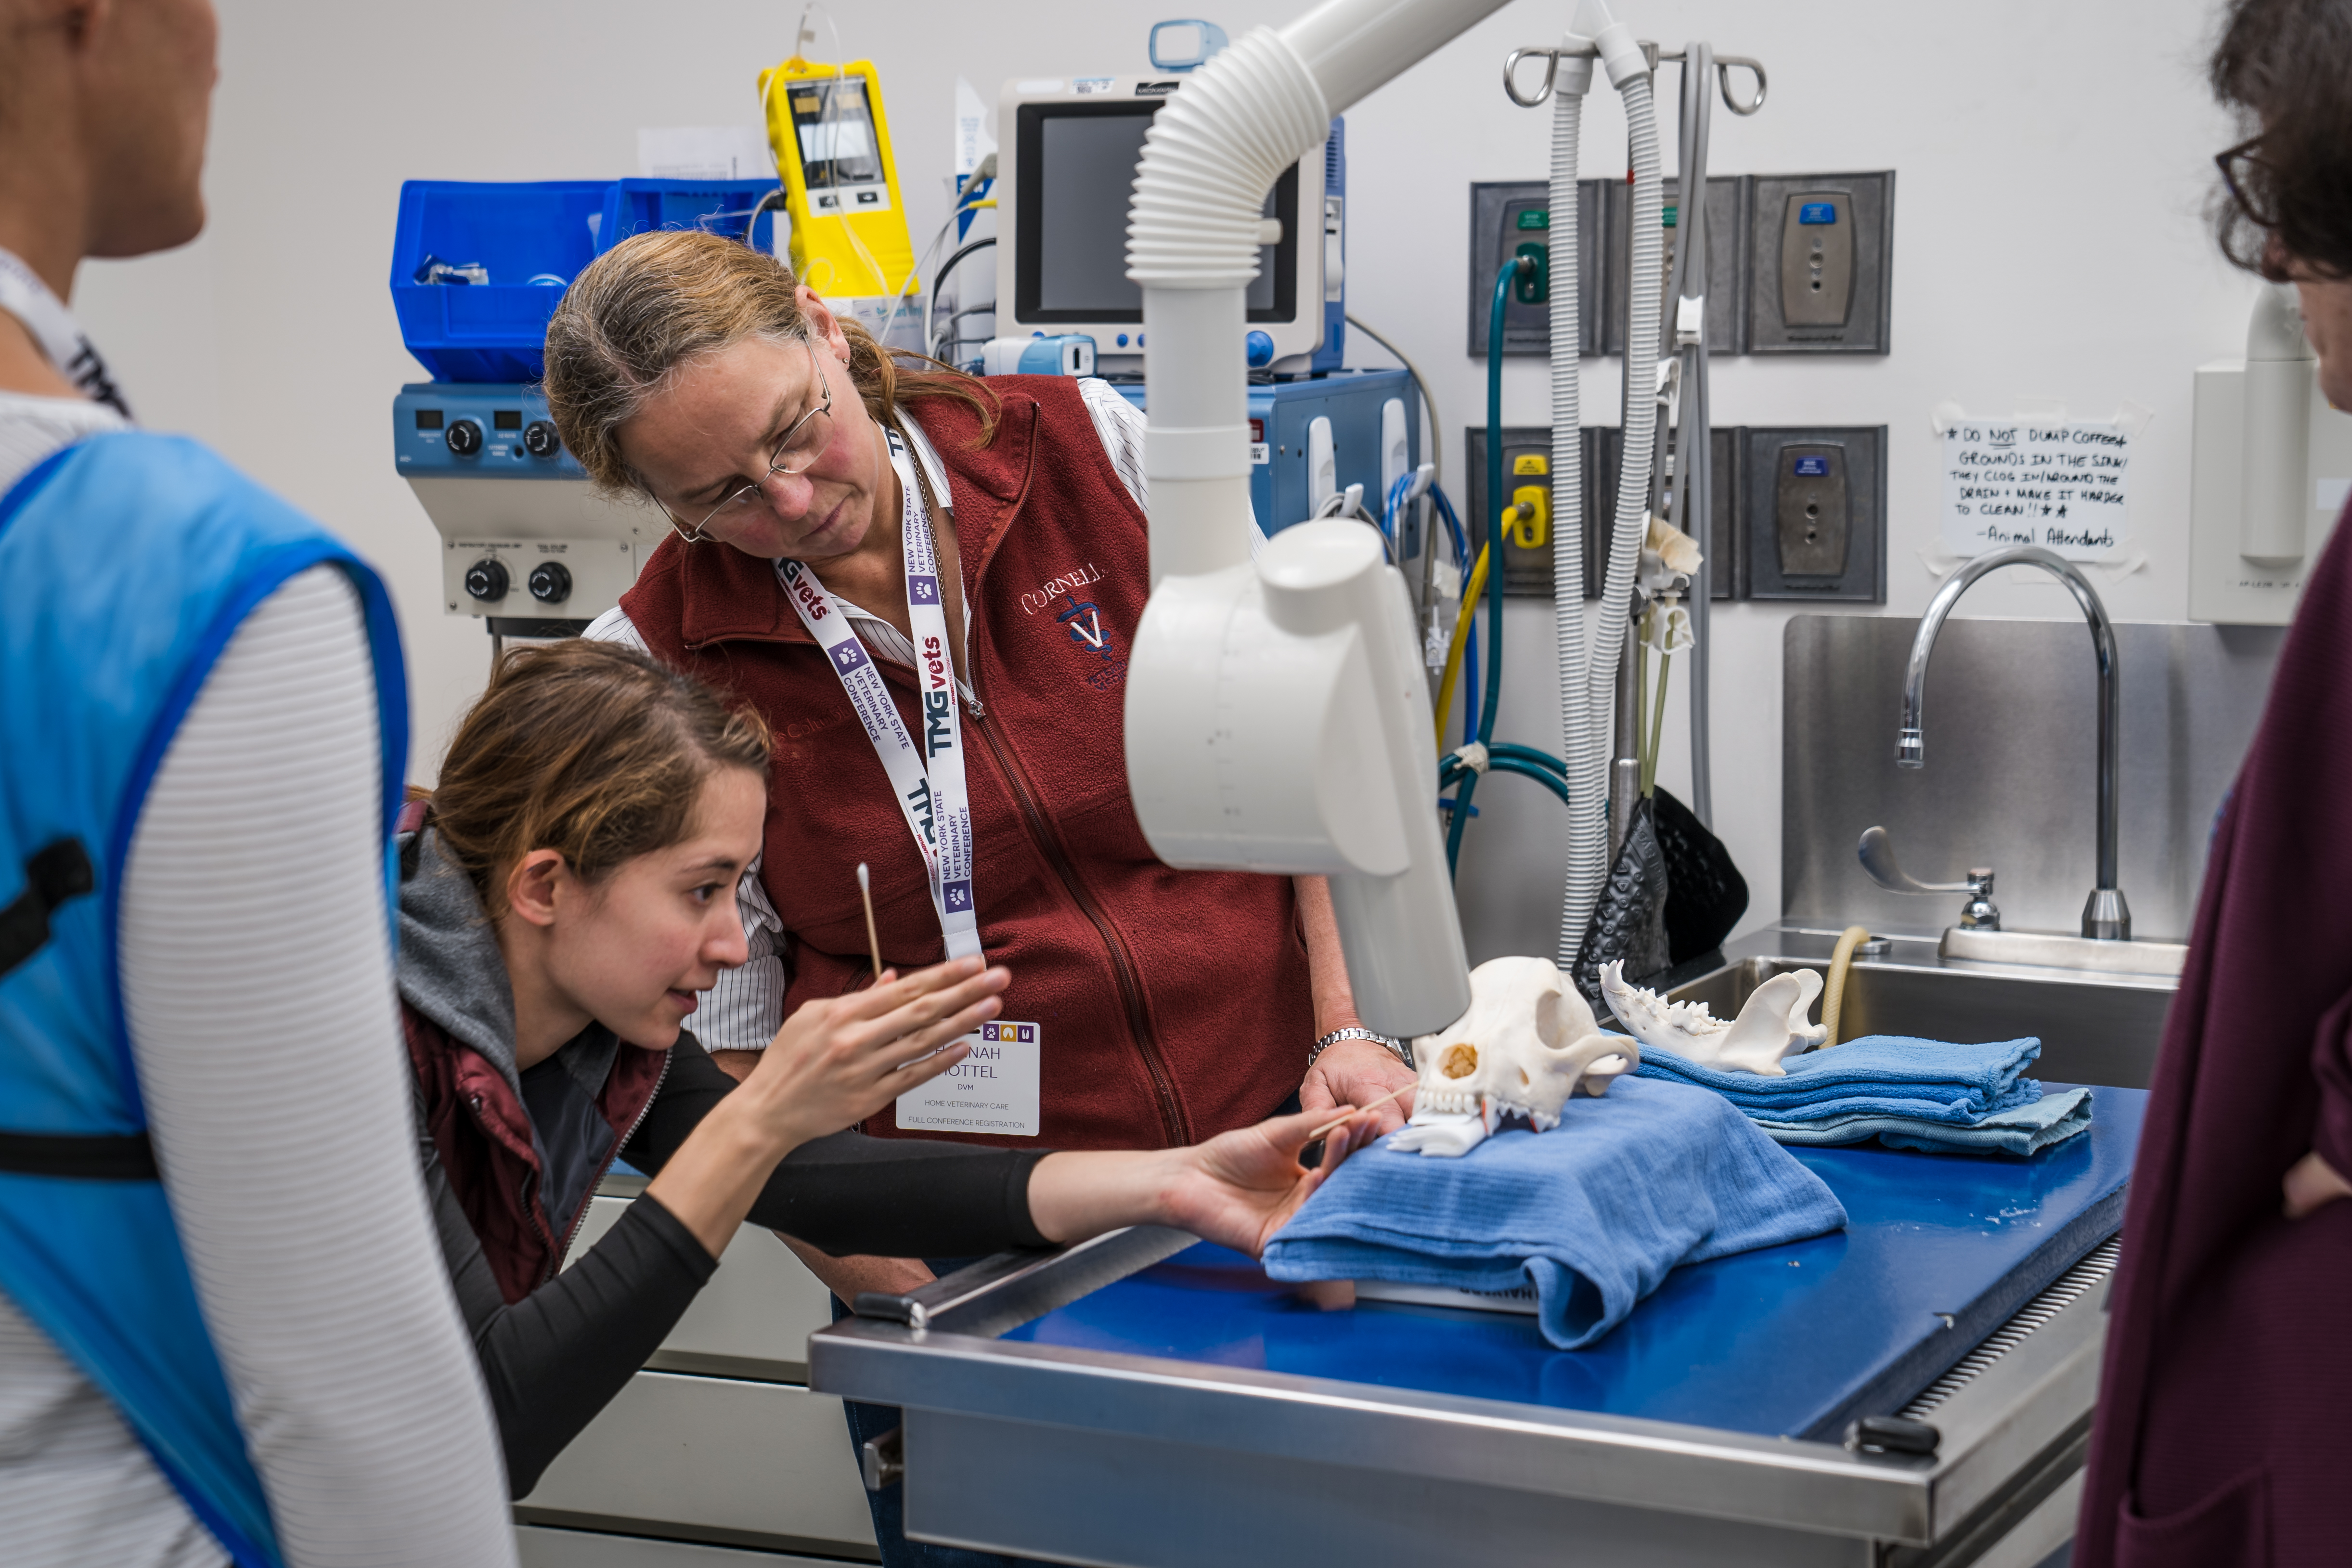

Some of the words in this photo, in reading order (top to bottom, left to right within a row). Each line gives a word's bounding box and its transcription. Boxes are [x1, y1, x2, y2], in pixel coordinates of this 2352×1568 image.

[1964, 428, 1980, 442] DO
[1989, 428, 2017, 442] NOT
[2029, 428, 2069, 443] DUMP
[1960, 450, 2025, 466] GROUNDS
[2030, 454, 2052, 466] IN
[2056, 454, 2088, 467] THE
[1950, 470, 1978, 484] THEY
[1984, 470, 2015, 482] CLOG
[2097, 475, 2119, 485] THE
[1955, 503, 1970, 515] TO
[1960, 488, 1999, 500] DRAIN
[2017, 488, 2052, 501] MAKE
[2058, 490, 2075, 501] IT
[2081, 490, 2124, 505] HARDER
[914, 511, 926, 573] VETERINARY
[919, 506, 935, 574] CONFERENCE
[2047, 526, 2114, 547] Attendants
[843, 677, 881, 743] CONFERENCE
[854, 671, 889, 730] VETERINARY
[864, 666, 881, 689] NEW
[877, 690, 895, 719] YORK
[890, 719, 910, 750] STATE
[922, 636, 952, 758] TMGvets
[933, 790, 944, 822] STATE
[939, 824, 949, 853] YORK
[948, 814, 961, 879] VETERINARY
[959, 806, 971, 877] CONFERENCE
[942, 855, 951, 880] NEW
[947, 1101, 988, 1109] VETERINARY
[927, 1117, 974, 1126] CONFERENCE
[975, 1120, 1025, 1128] REGISTRATION
